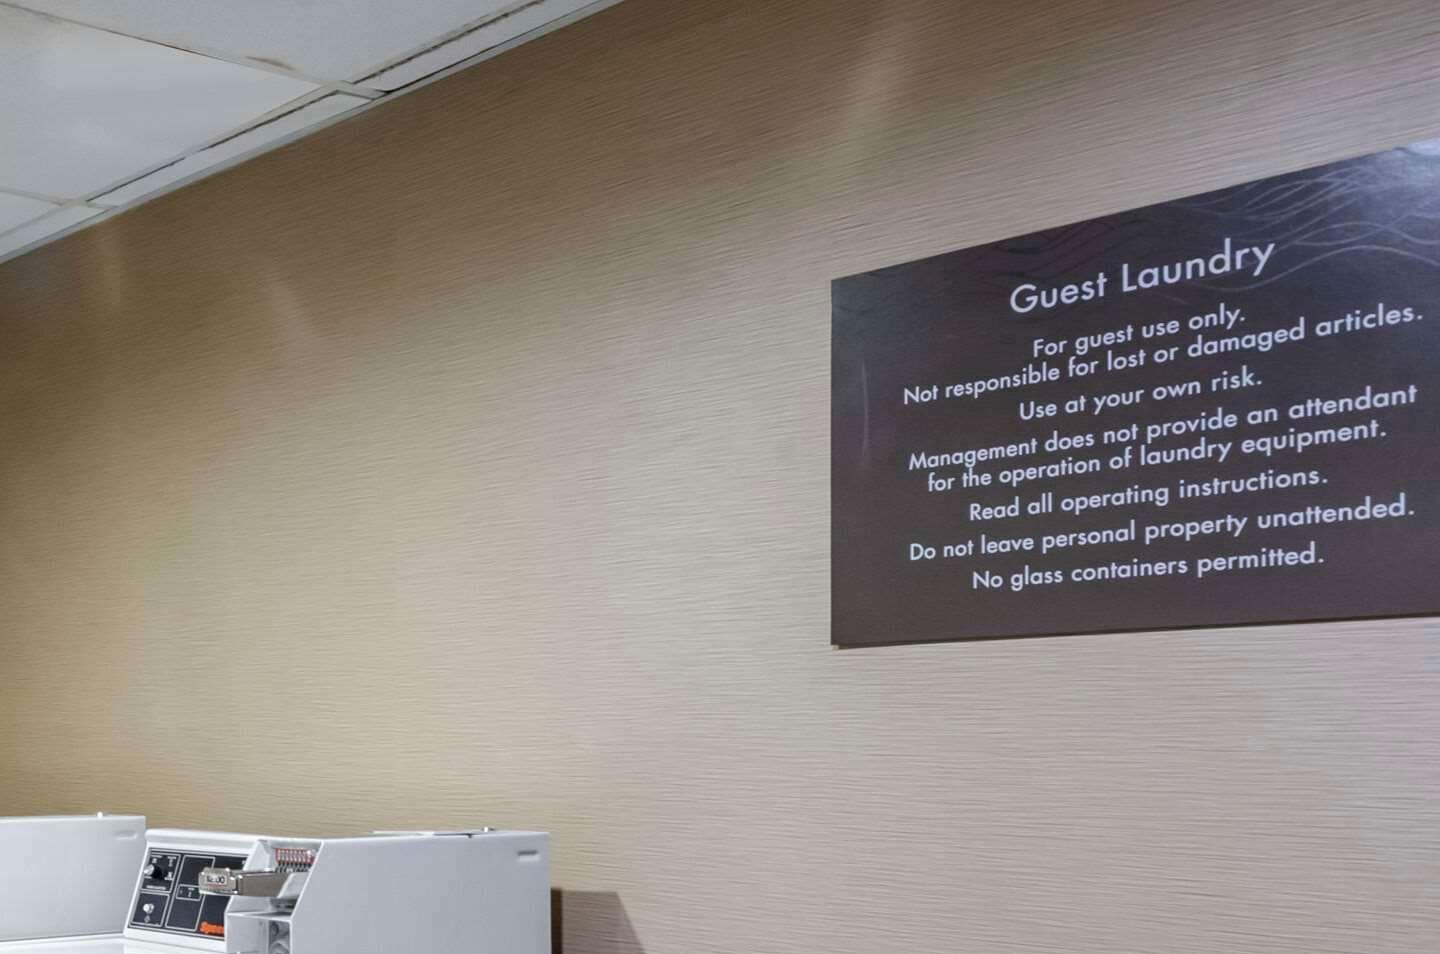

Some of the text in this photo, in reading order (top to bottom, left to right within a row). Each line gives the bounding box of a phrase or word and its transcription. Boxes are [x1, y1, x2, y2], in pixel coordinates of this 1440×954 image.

[1010, 238, 1275, 313] Guest Laundry
[904, 303, 1422, 405] Not responsible for lost or damaged articles.
[1034, 303, 1245, 357] For guest use only.
[1020, 365, 1262, 420] Use at your own risk.
[909, 385, 1418, 470] Management does not provide an attendant
[928, 420, 1386, 492] for the operation of laundry equipment.
[910, 492, 1414, 560] Do not leave personal property unattended.
[970, 470, 1327, 520] Read all operating instructions.
[973, 541, 1324, 591] No glass containers permitted.
